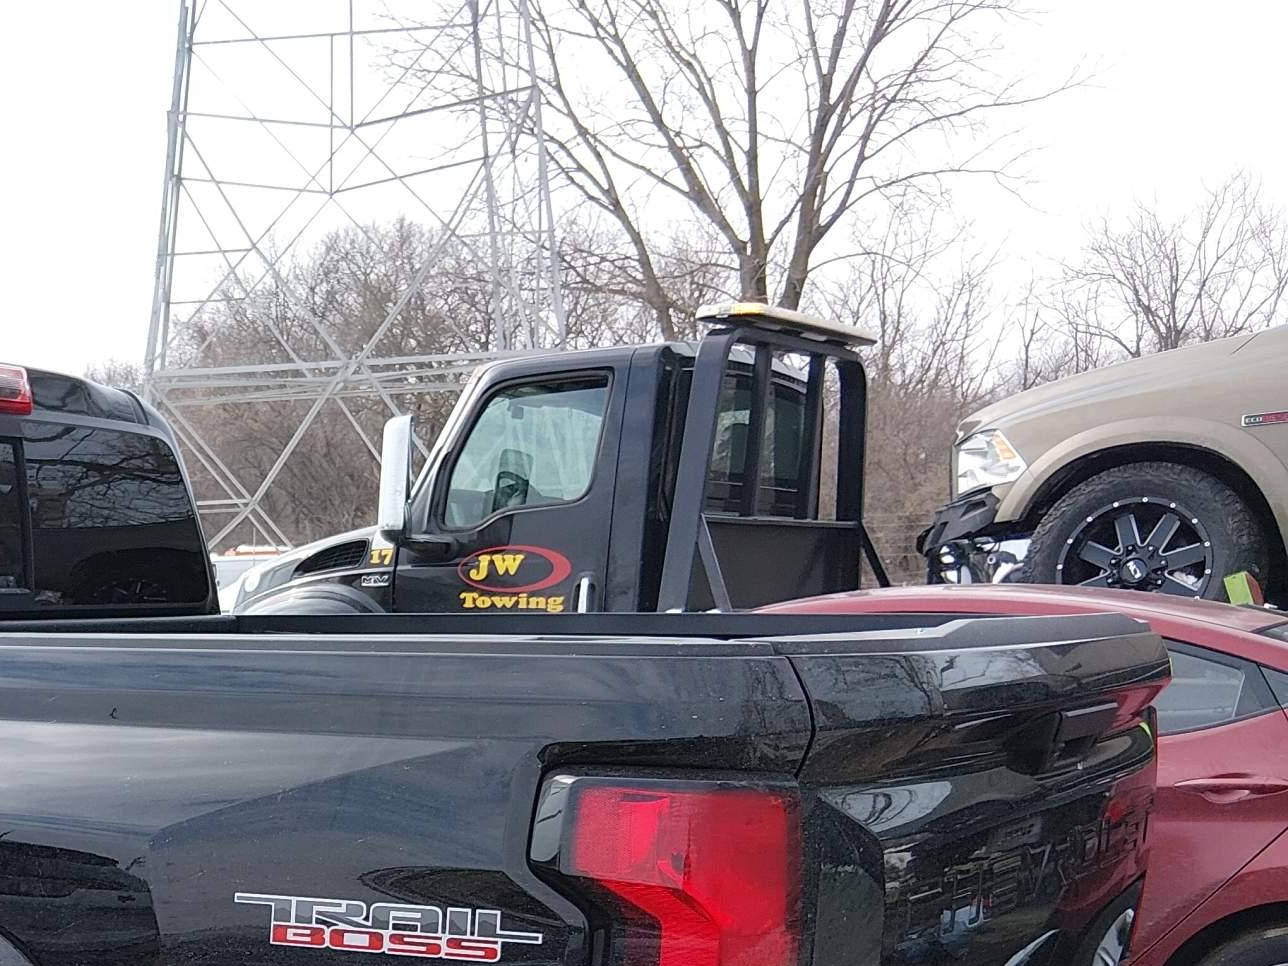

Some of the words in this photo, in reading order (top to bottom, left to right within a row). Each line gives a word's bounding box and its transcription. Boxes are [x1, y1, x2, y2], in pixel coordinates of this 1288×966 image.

[369, 549, 393, 566] 17
[469, 554, 525, 581] JW
[459, 592, 565, 613] Towing
[234, 892, 543, 945] TRAIL
[269, 922, 502, 963] BOSS
